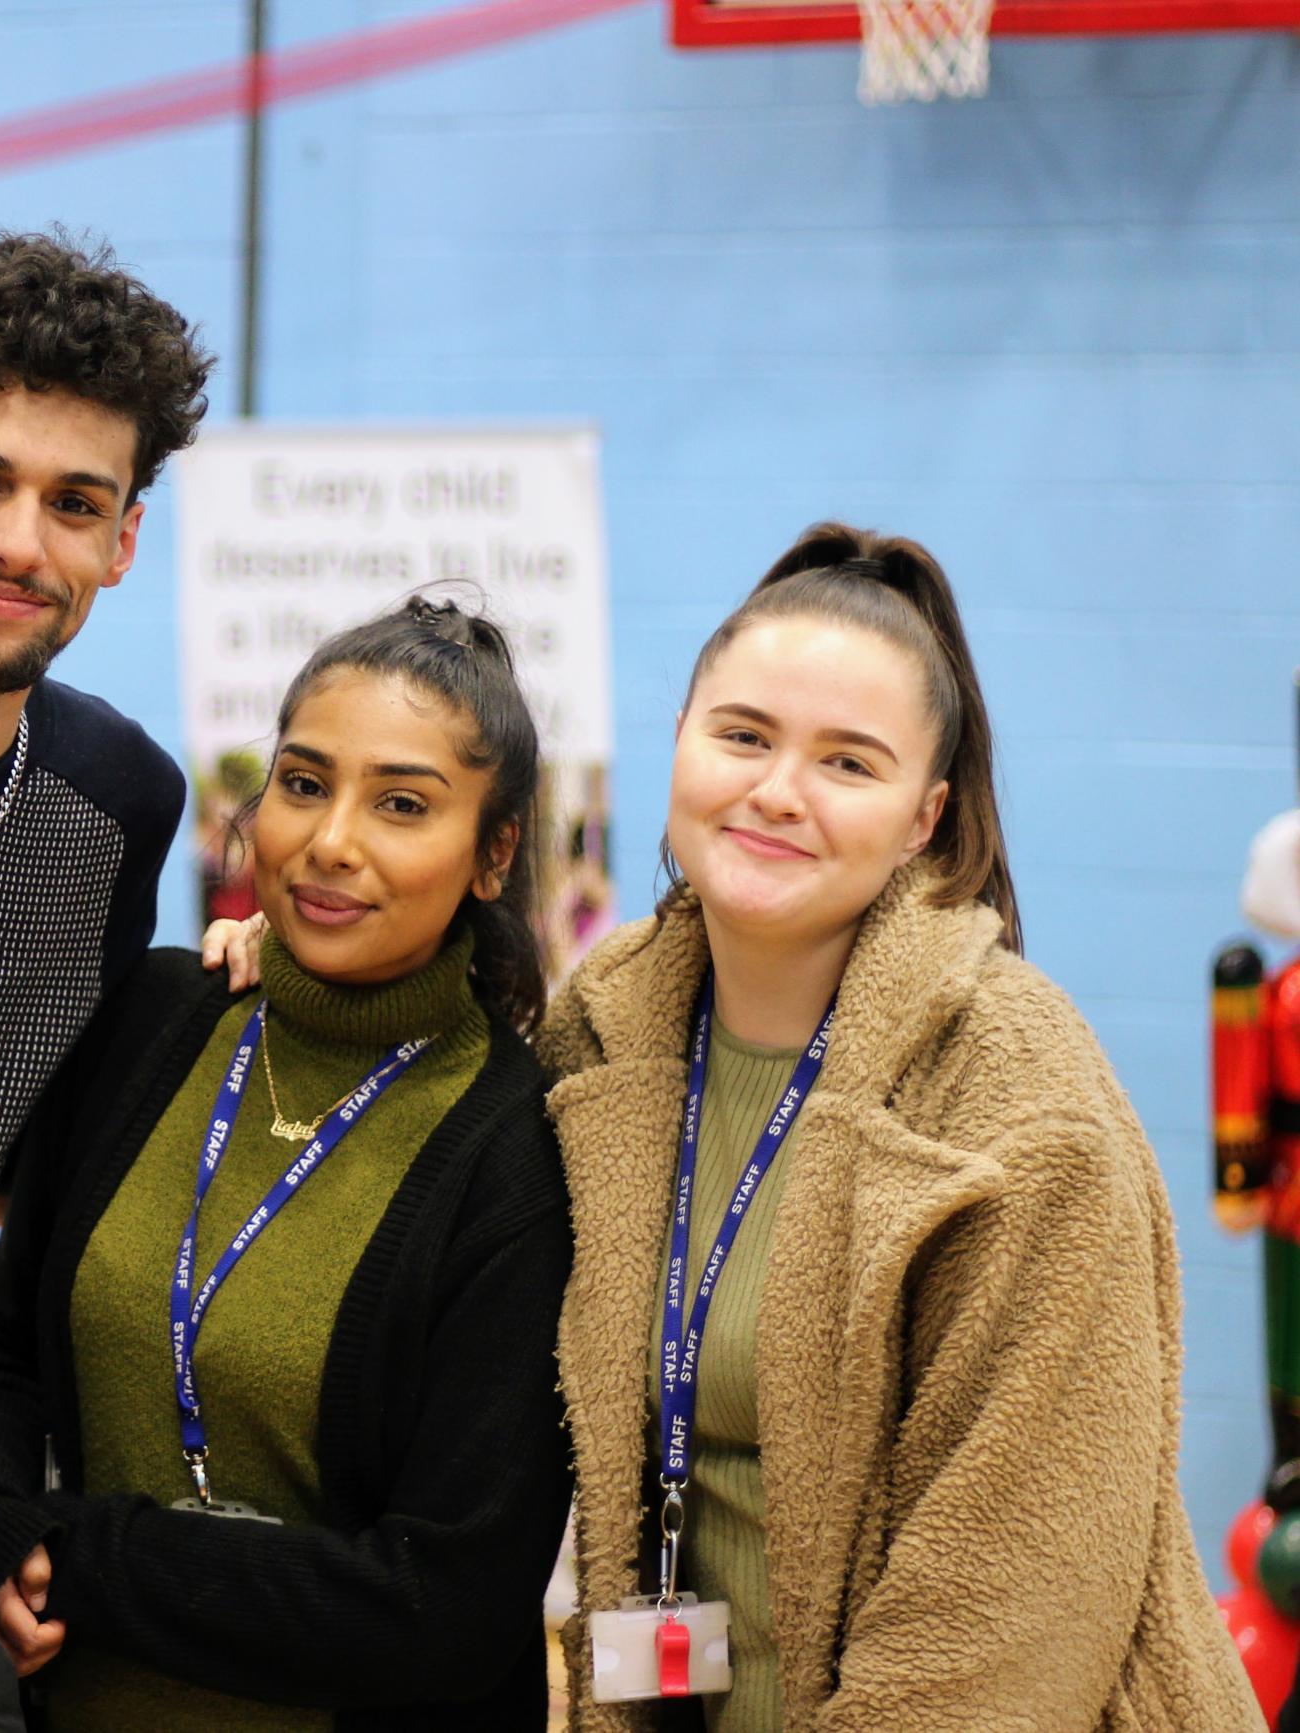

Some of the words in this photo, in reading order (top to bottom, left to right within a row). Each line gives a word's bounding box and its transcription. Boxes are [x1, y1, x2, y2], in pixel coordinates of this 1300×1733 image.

[254, 459, 390, 528] Every
[402, 461, 520, 518] child
[203, 535, 417, 585] deserves
[488, 535, 578, 591] live
[694, 1014, 707, 1062] STAFF
[227, 1045, 251, 1093] STAFF
[204, 1119, 228, 1170] STAFF
[685, 1094, 699, 1144] STAFF
[191, 1275, 216, 1323] STAFF
[232, 1206, 268, 1250] STAFF
[285, 1141, 324, 1185] STAFF
[340, 1076, 380, 1121] STAFF
[396, 1037, 428, 1062] STA
[676, 1176, 690, 1225] STAFF
[680, 1329, 698, 1383] STAFF
[700, 1244, 724, 1296] STAFF
[732, 1163, 760, 1214] STAFF
[769, 1086, 800, 1136] STAFF
[176, 1237, 191, 1288] STAFF
[669, 1257, 682, 1308] STAFF
[173, 1322, 185, 1373] STAFF
[669, 1415, 686, 1468] STAFF
